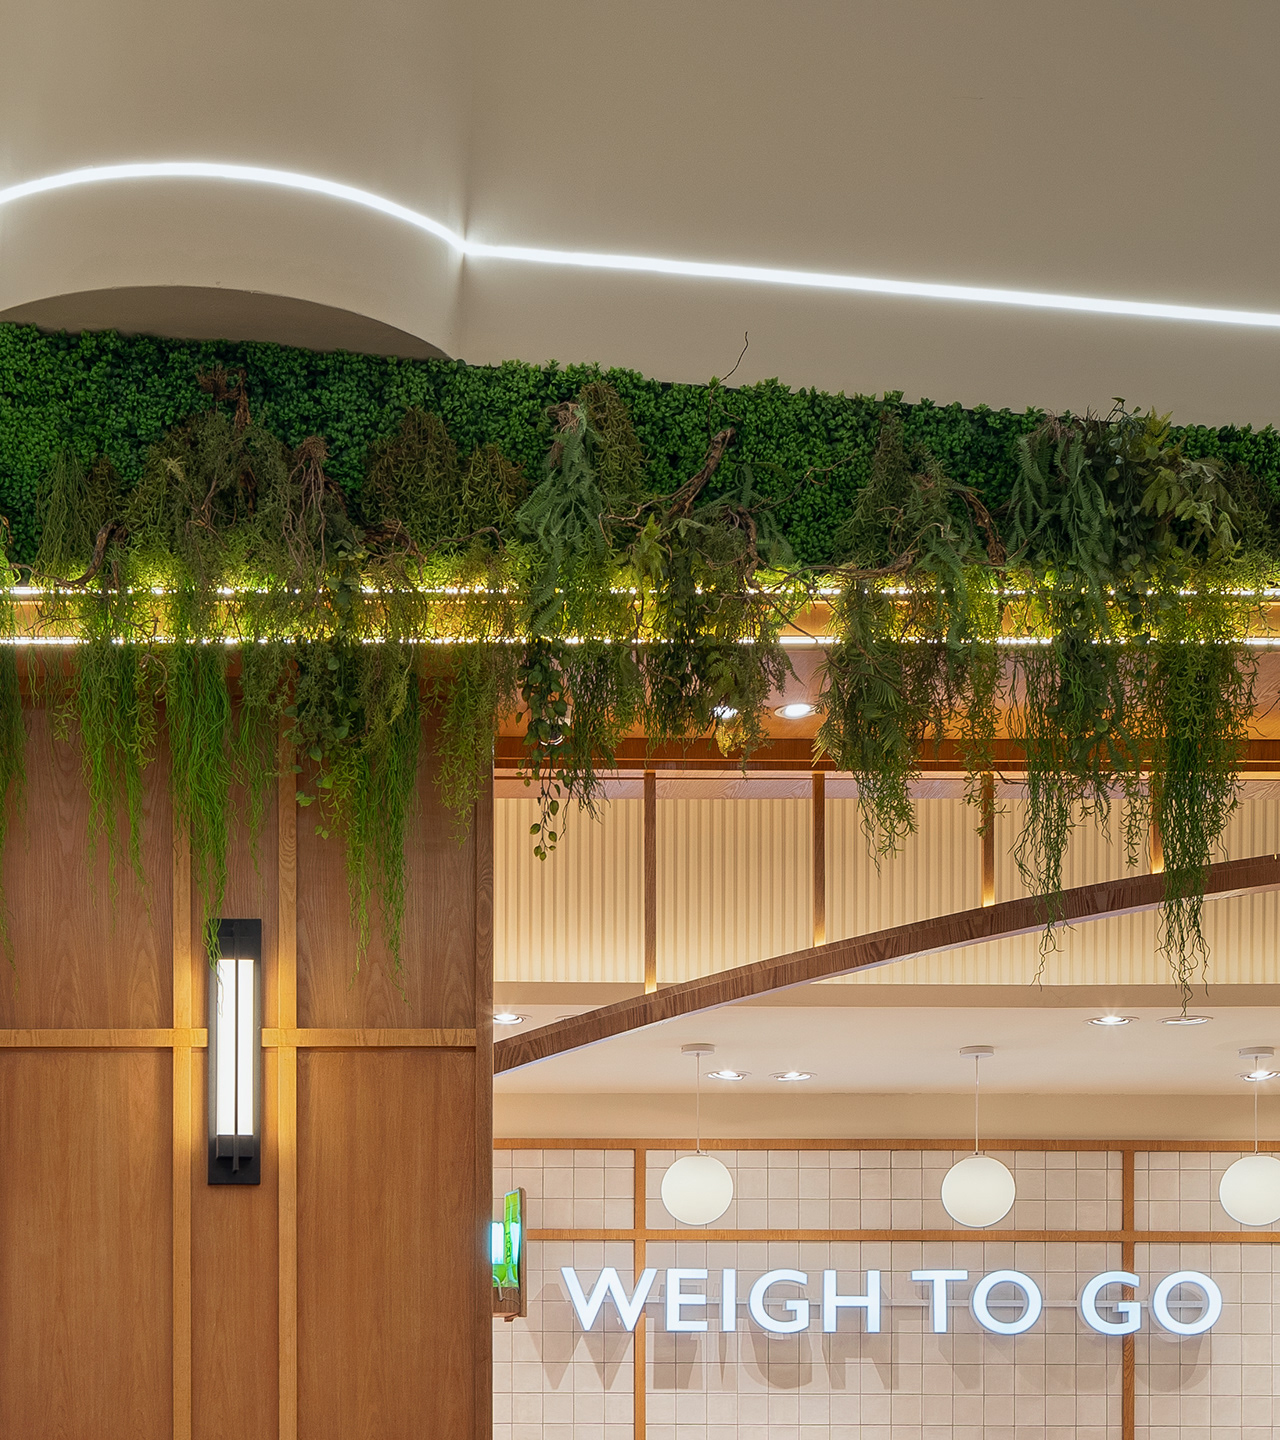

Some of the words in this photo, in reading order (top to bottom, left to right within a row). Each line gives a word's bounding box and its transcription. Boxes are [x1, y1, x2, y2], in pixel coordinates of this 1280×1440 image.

[560, 1267, 881, 1333] WEIGH
[911, 1269, 1042, 1334] TO
[1081, 1270, 1223, 1335] GO
